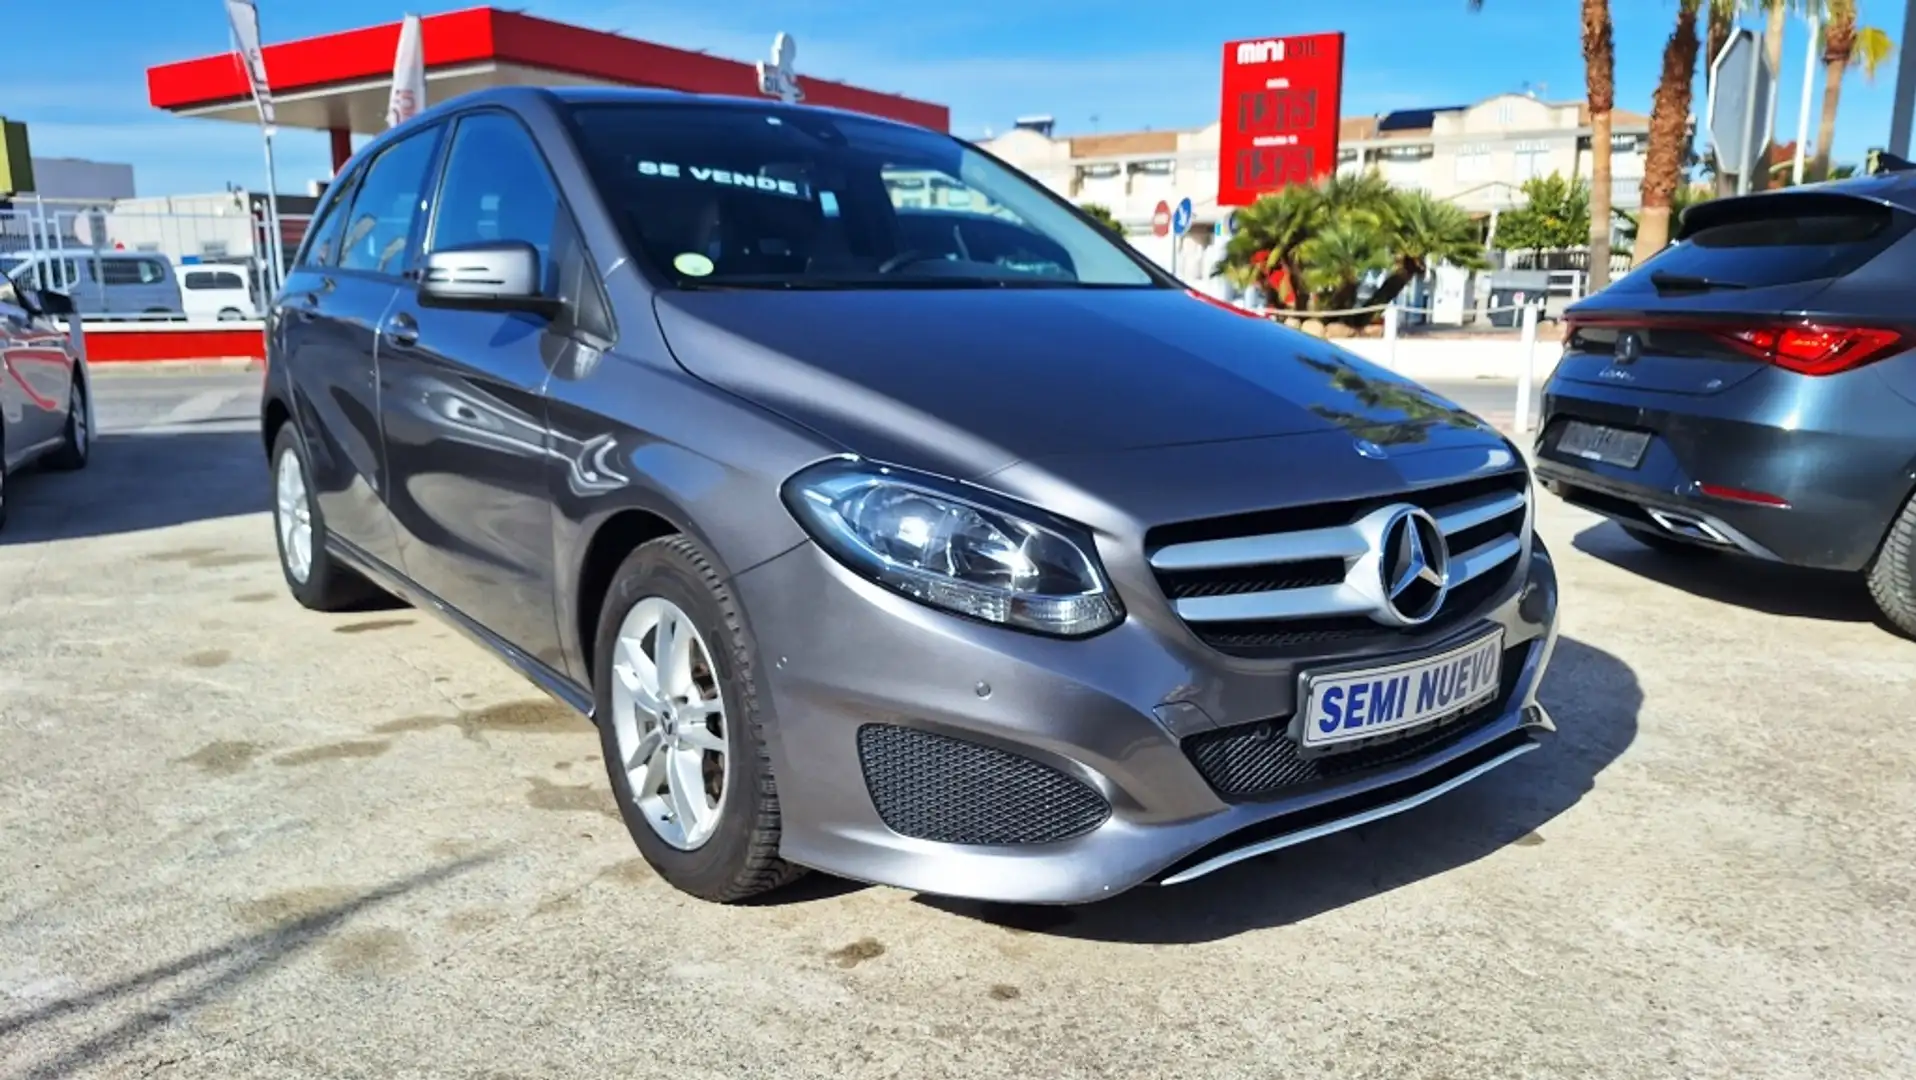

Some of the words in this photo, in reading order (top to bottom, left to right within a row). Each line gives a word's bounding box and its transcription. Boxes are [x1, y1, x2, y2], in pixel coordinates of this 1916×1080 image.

[638, 161, 680, 178] SE
[689, 166, 798, 195] VENDE
[1318, 676, 1410, 733] SEMI
[1416, 643, 1496, 714] NUEVO
